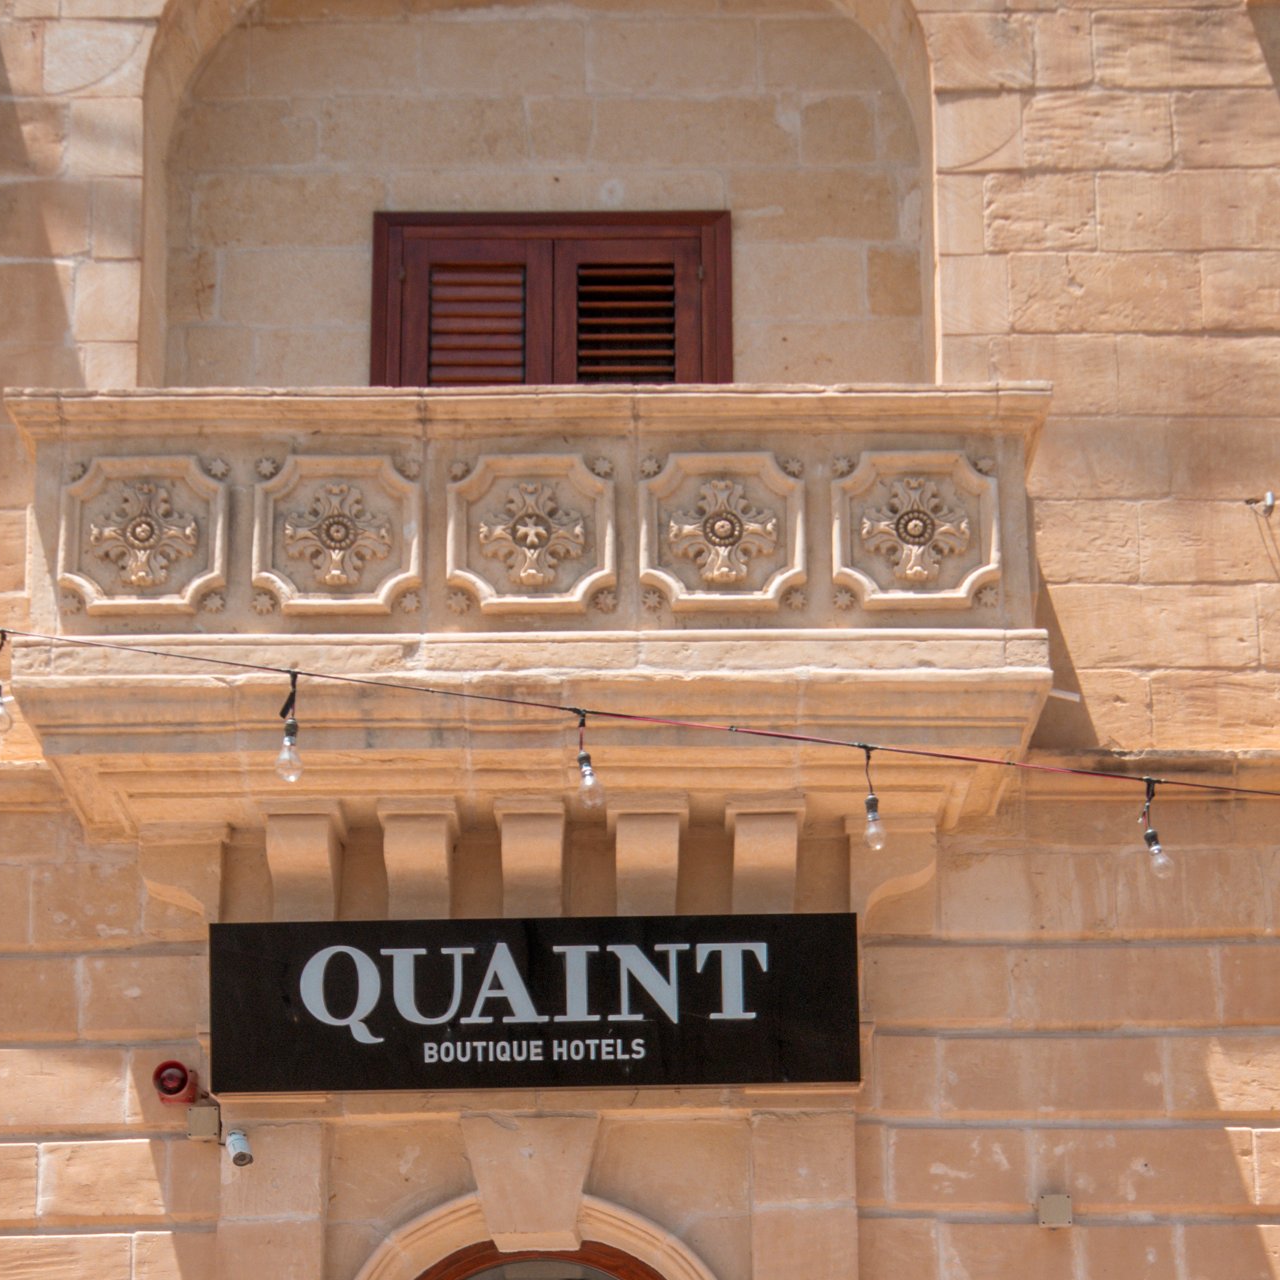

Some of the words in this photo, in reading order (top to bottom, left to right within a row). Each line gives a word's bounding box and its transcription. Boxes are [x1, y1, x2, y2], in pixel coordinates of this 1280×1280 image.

[299, 941, 768, 1044] QUAINT
[423, 1040, 544, 1064] BOUTIQUE
[552, 1038, 646, 1061] HOTELS
